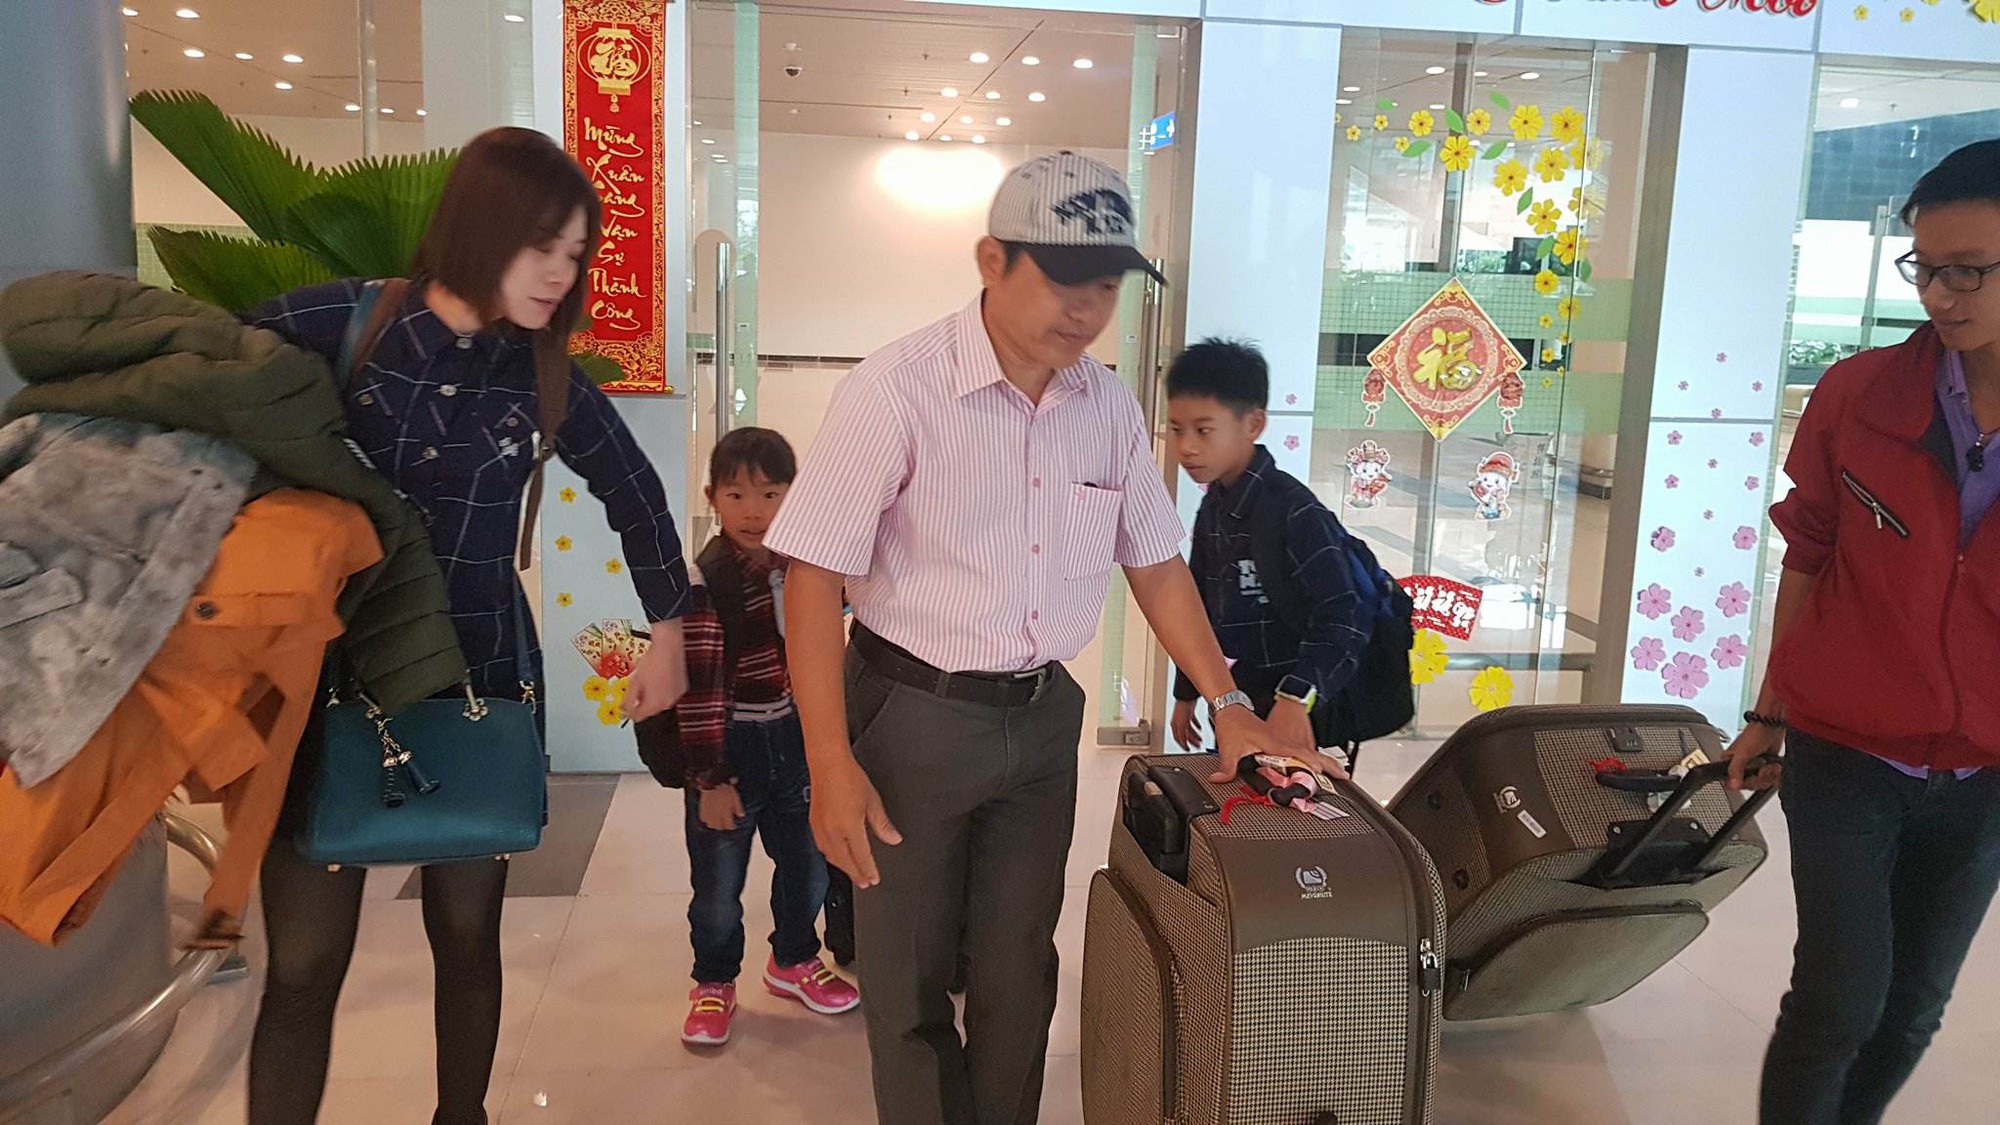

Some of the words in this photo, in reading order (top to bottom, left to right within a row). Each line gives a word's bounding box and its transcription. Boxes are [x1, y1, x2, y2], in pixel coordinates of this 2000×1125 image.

[591, 41, 637, 77] 福
[584, 117, 644, 157] Mừng
[585, 153, 645, 195] Xuân
[598, 241, 625, 266] Sự
[588, 268, 647, 297] Thành
[591, 300, 640, 330] Công
